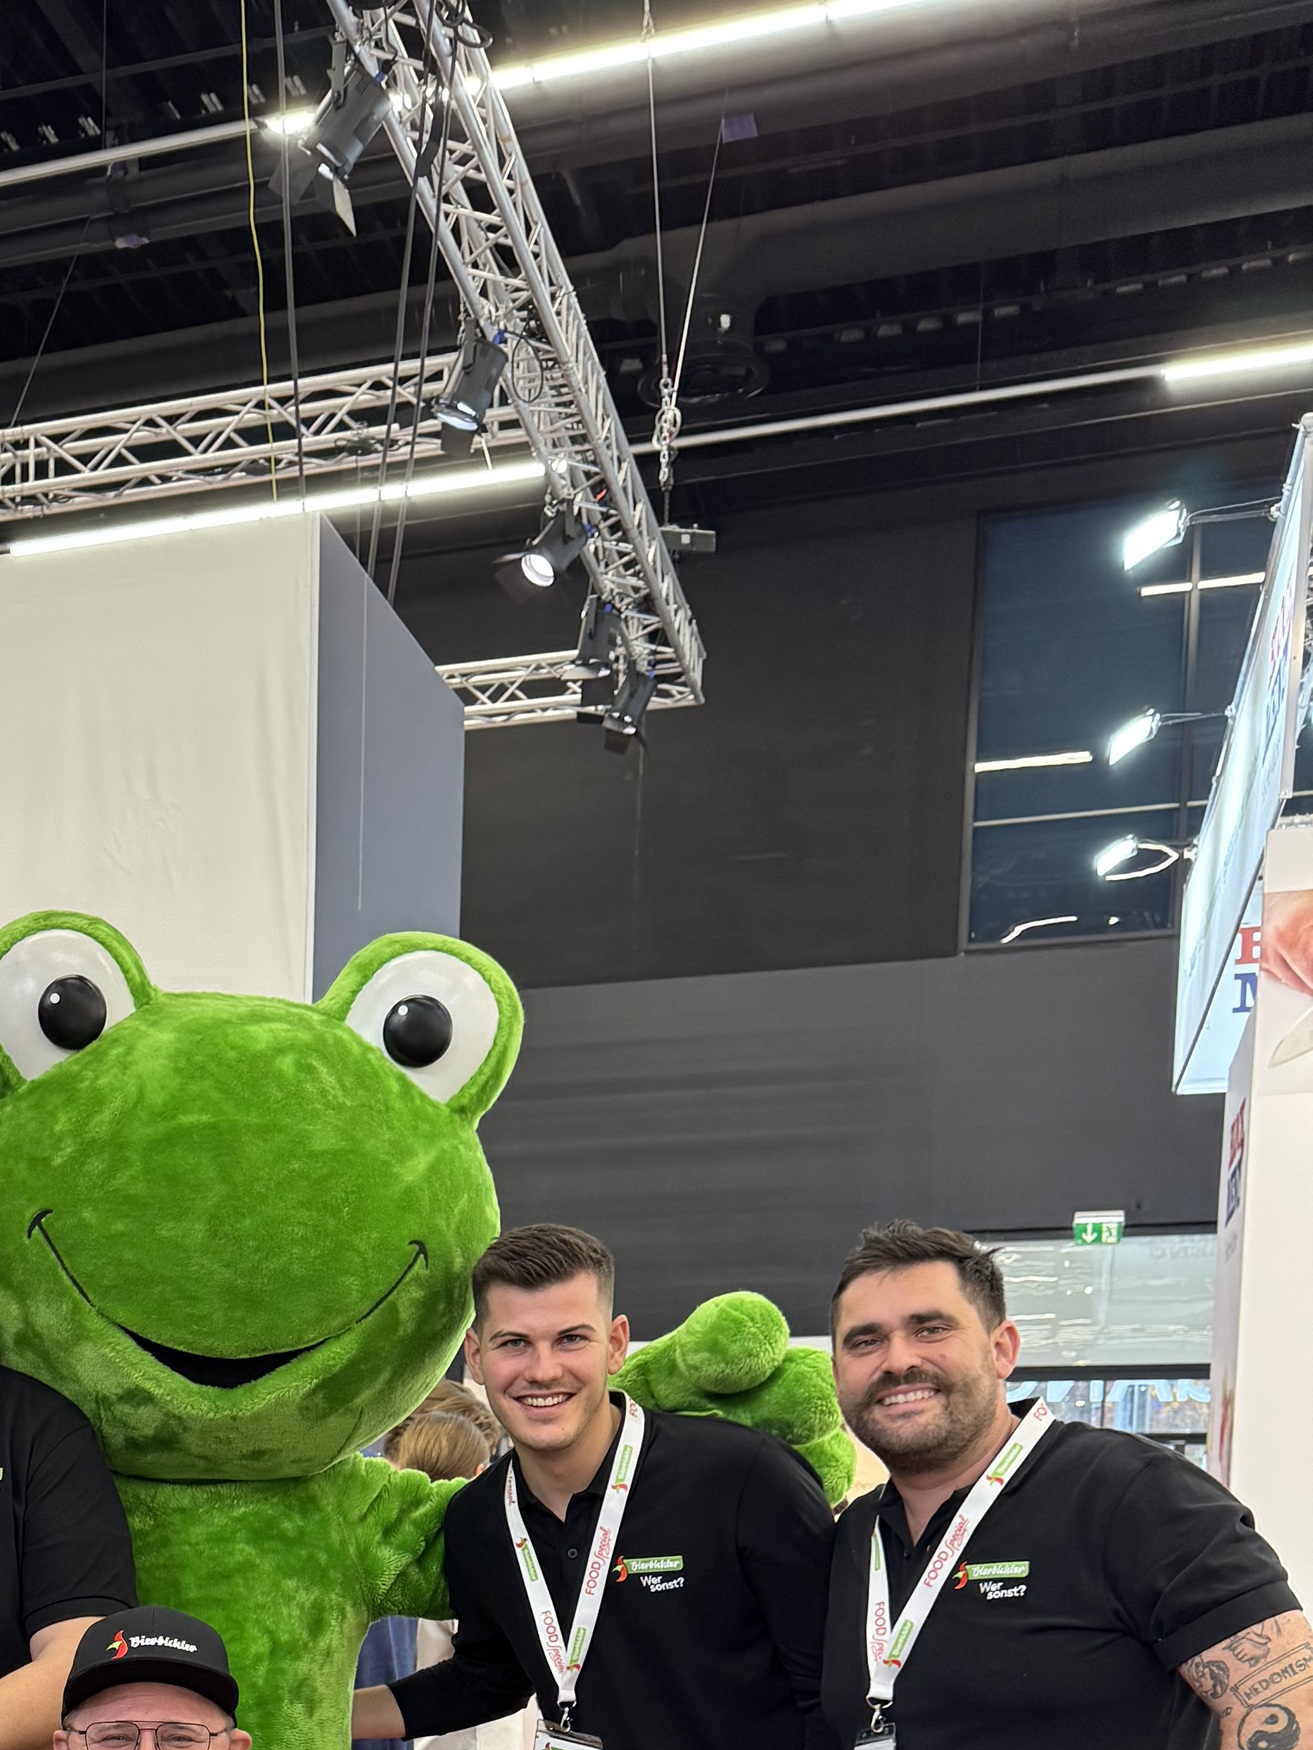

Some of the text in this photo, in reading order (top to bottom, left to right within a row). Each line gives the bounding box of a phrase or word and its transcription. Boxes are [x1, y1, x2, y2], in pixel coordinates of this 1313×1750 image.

[924, 1514, 969, 1588] FOOD Special
[585, 1526, 612, 1596] FOOD Special
[640, 1575, 663, 1587] Wer
[650, 1577, 684, 1592] sonst?
[980, 1582, 1004, 1593] Wer
[987, 1585, 1027, 1600] sonst?
[542, 1610, 559, 1643] FOOD
[874, 1601, 887, 1636] FOOD
[129, 1636, 197, 1652] Bierbichler
